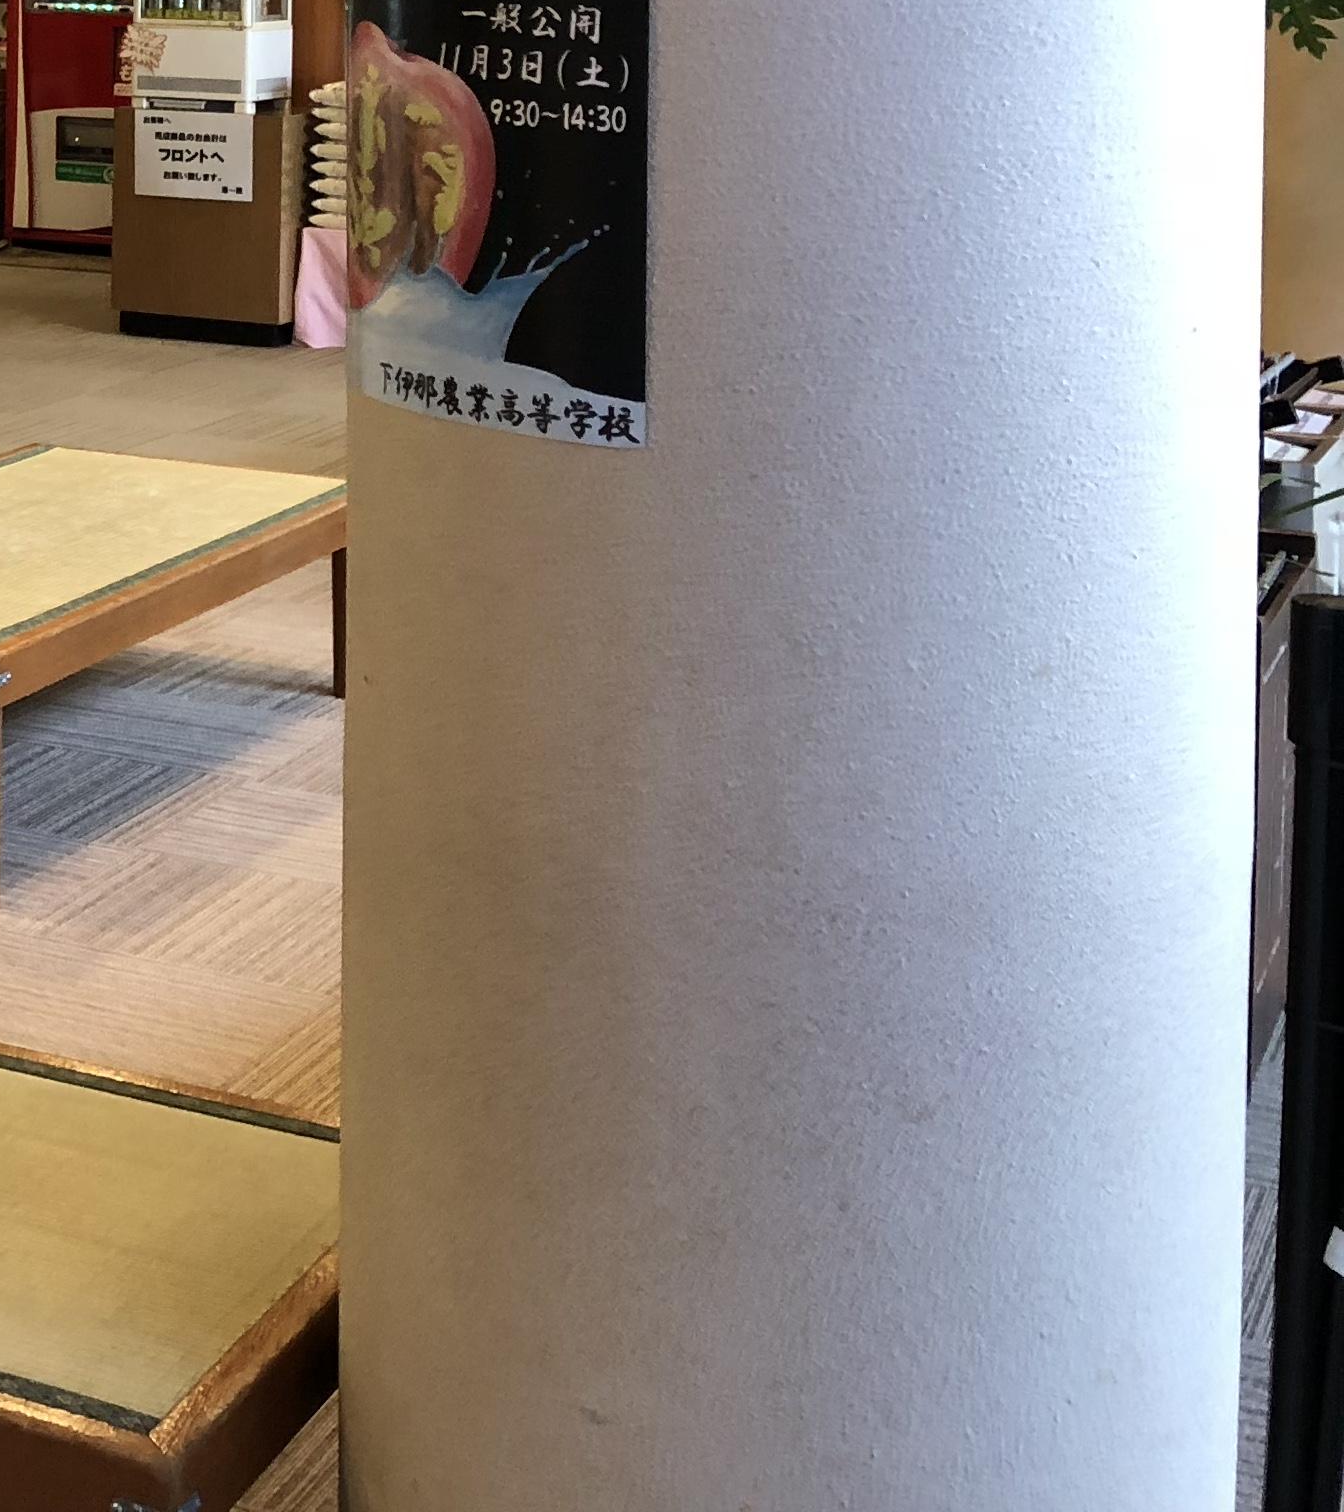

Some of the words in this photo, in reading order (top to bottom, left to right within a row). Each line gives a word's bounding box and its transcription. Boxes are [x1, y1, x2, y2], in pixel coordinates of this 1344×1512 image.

[461, 1, 603, 45] 一般公開
[158, 147, 225, 164] フロントへ
[379, 361, 641, 444] 下伊那農業高等学校
